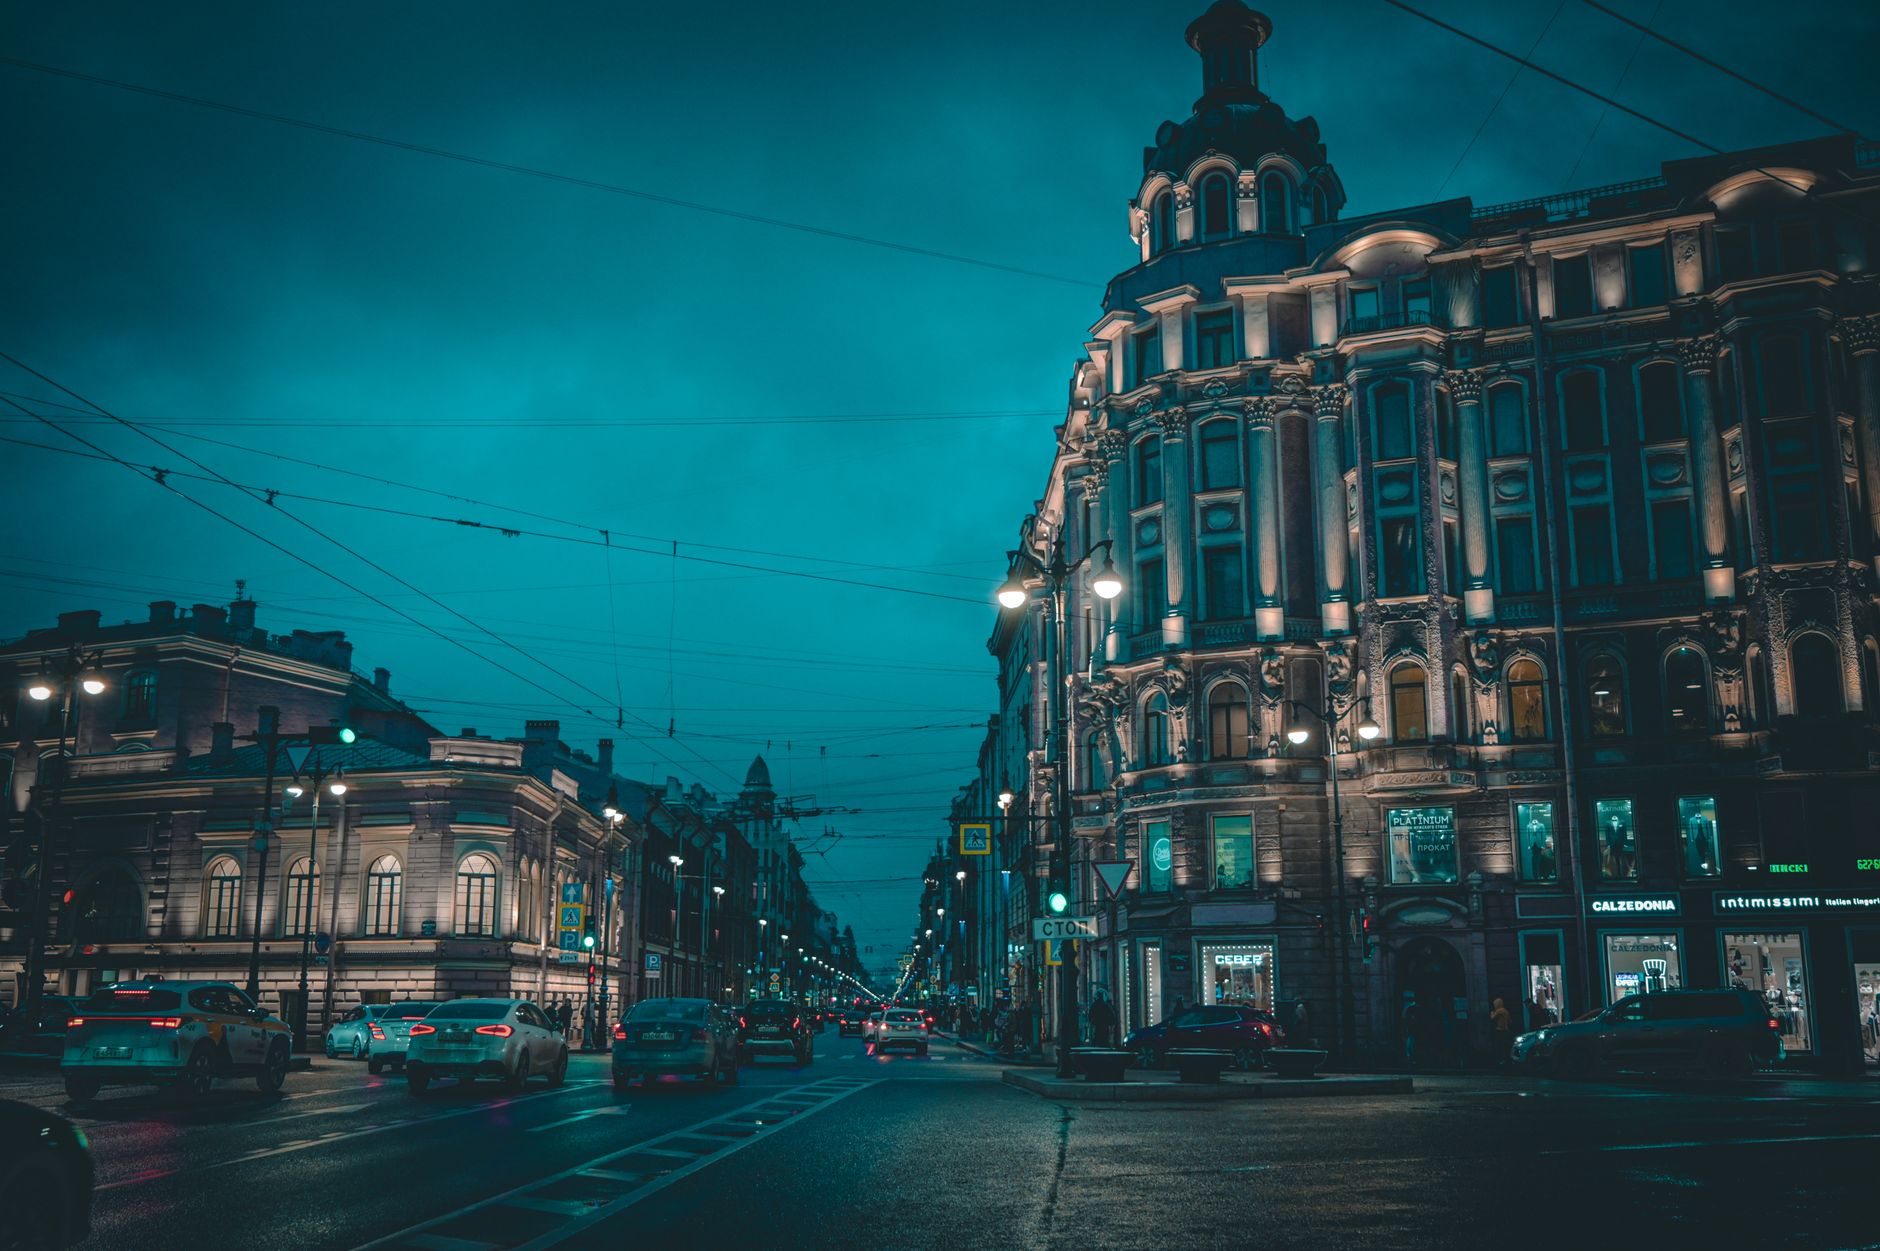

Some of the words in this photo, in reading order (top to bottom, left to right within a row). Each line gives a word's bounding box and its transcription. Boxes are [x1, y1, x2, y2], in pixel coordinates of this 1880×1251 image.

[1393, 815, 1449, 826] PLATINIUM
[1417, 844, 1450, 852] ПРОКАТ
[1592, 899, 1676, 912] CALZEDONIA
[1721, 896, 1820, 908] intimissimi
[1042, 920, 1088, 936] СТОП
[1611, 944, 1673, 952] CALZEDONIA
[1215, 954, 1263, 965] СЕВЕР
